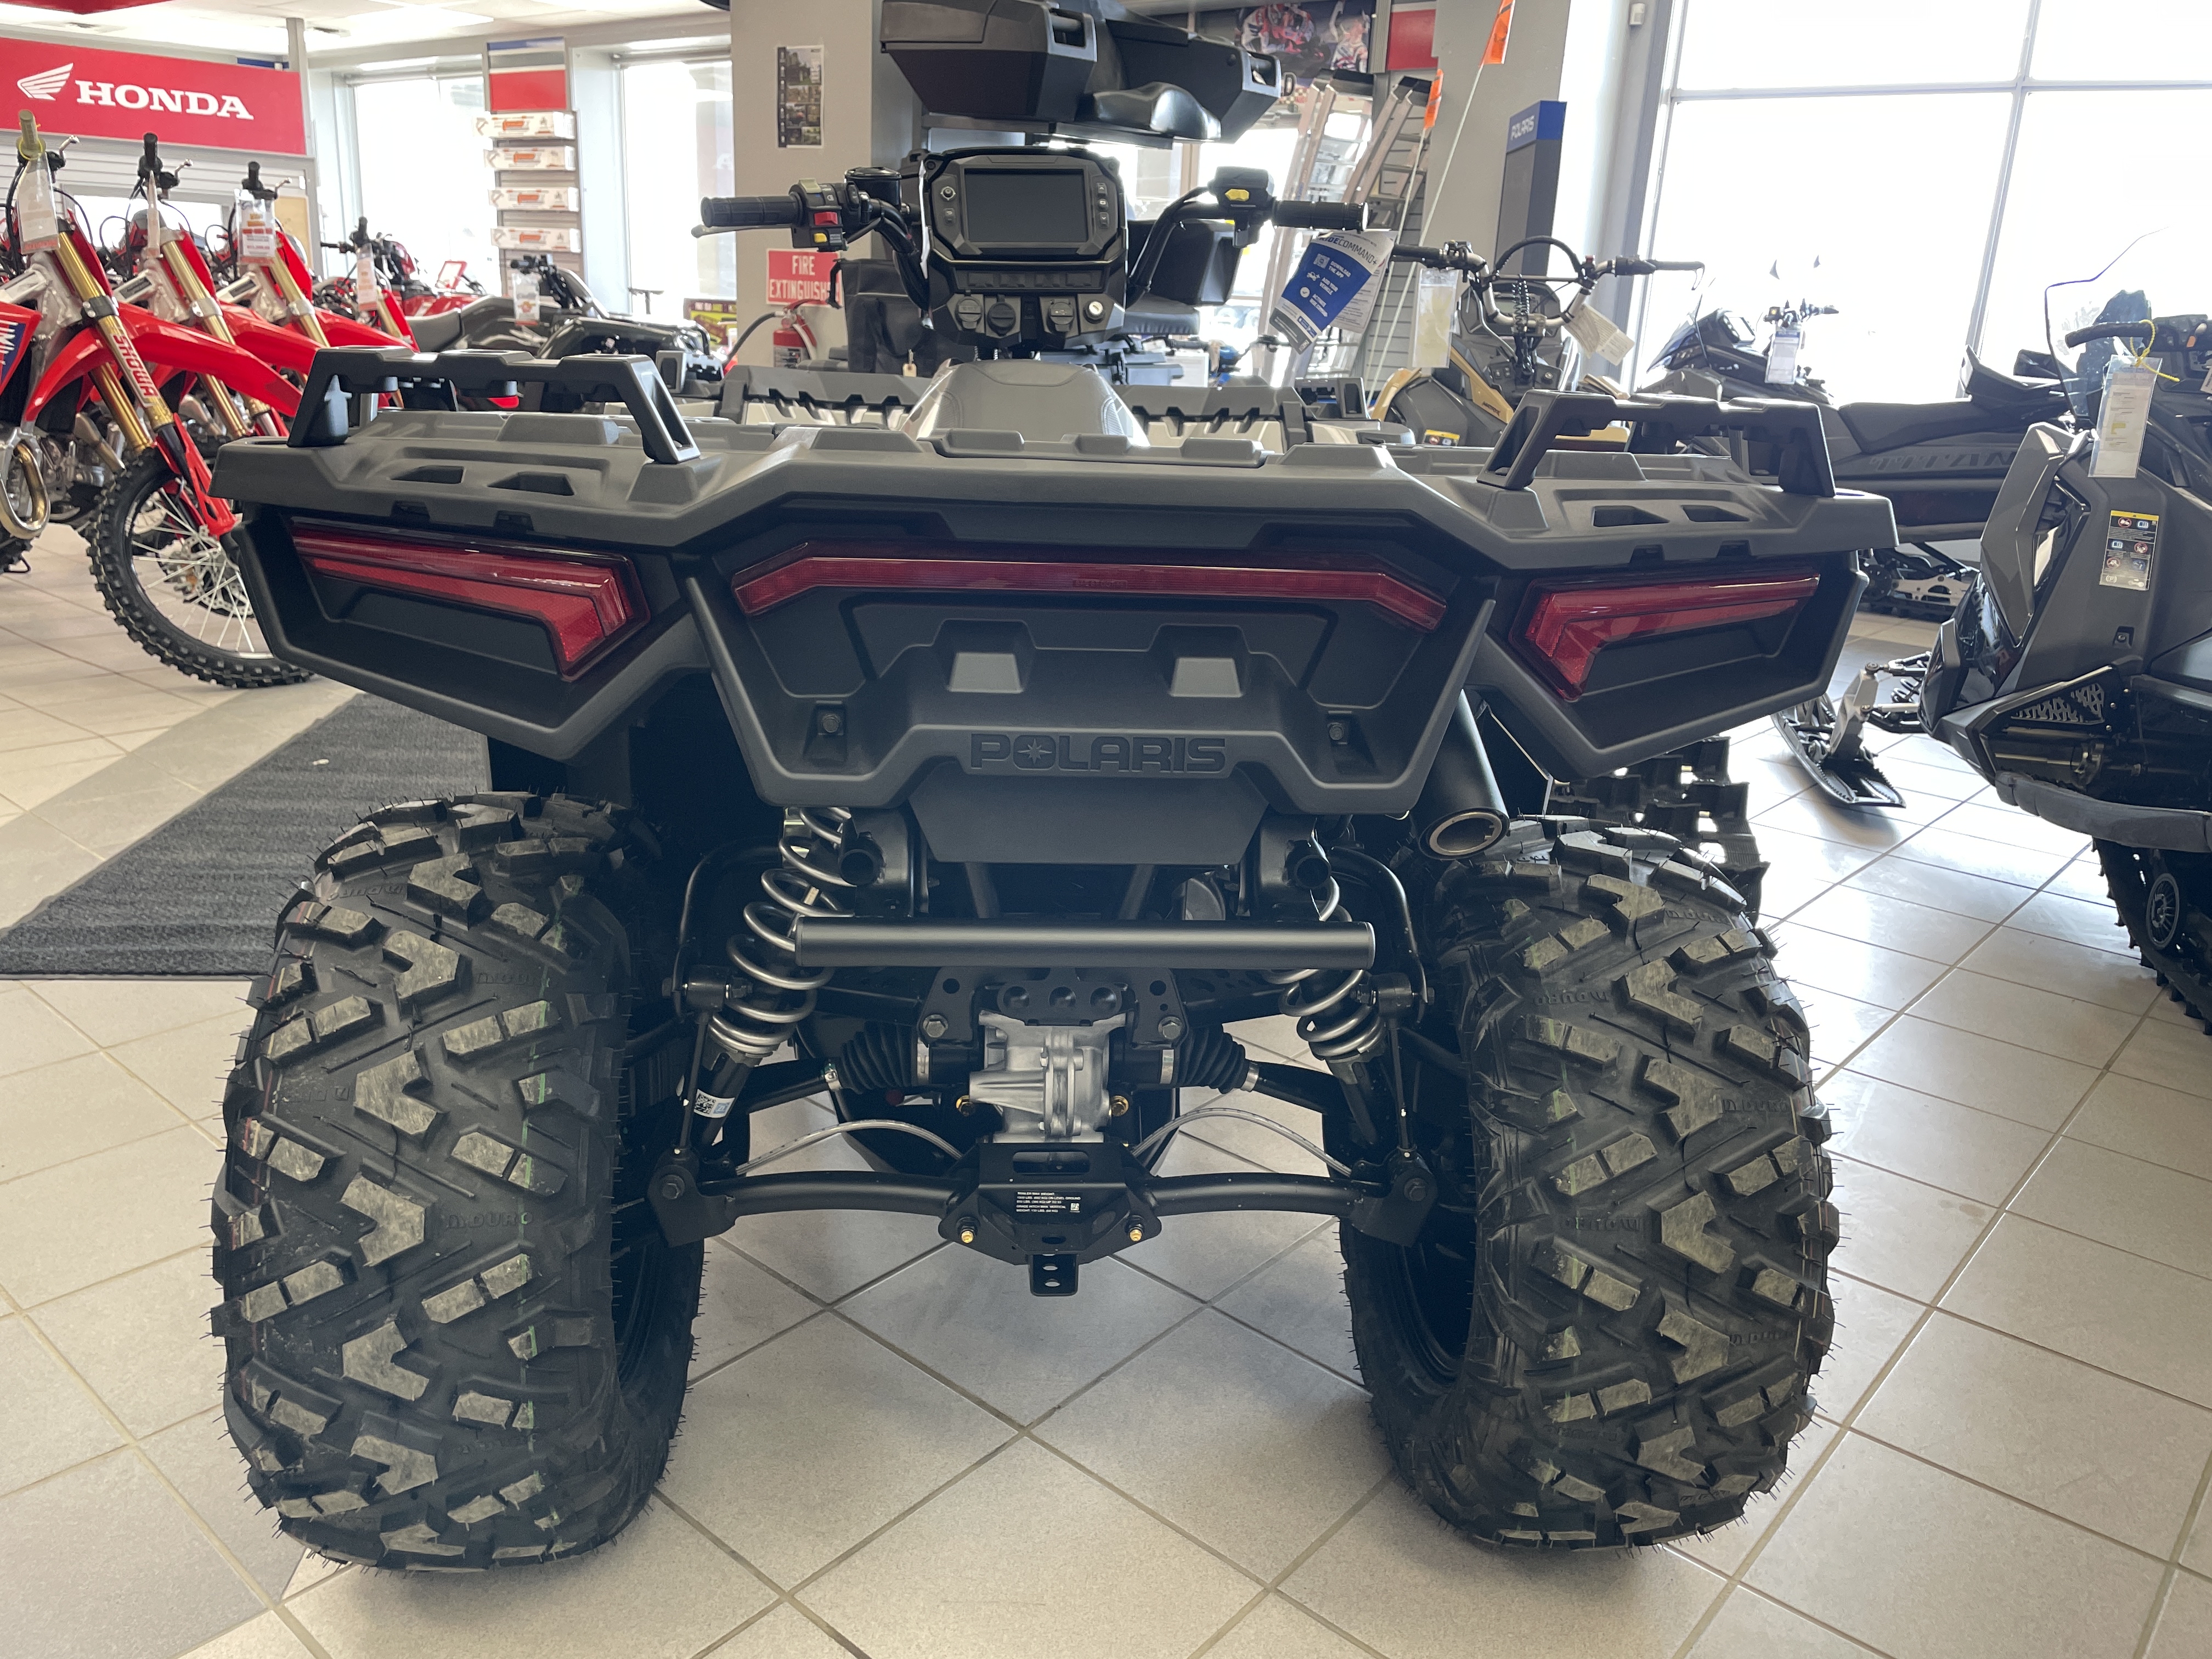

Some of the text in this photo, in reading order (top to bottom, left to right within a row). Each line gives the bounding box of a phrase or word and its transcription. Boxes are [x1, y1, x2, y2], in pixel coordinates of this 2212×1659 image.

[75, 80, 254, 120] HONDA
[1510, 115, 1534, 141] POLARIS
[792, 255, 816, 275] FIRE
[112, 334, 159, 396] SHOWA
[1869, 451, 2017, 471] TITAN
[970, 733, 1226, 774] POLARIS
